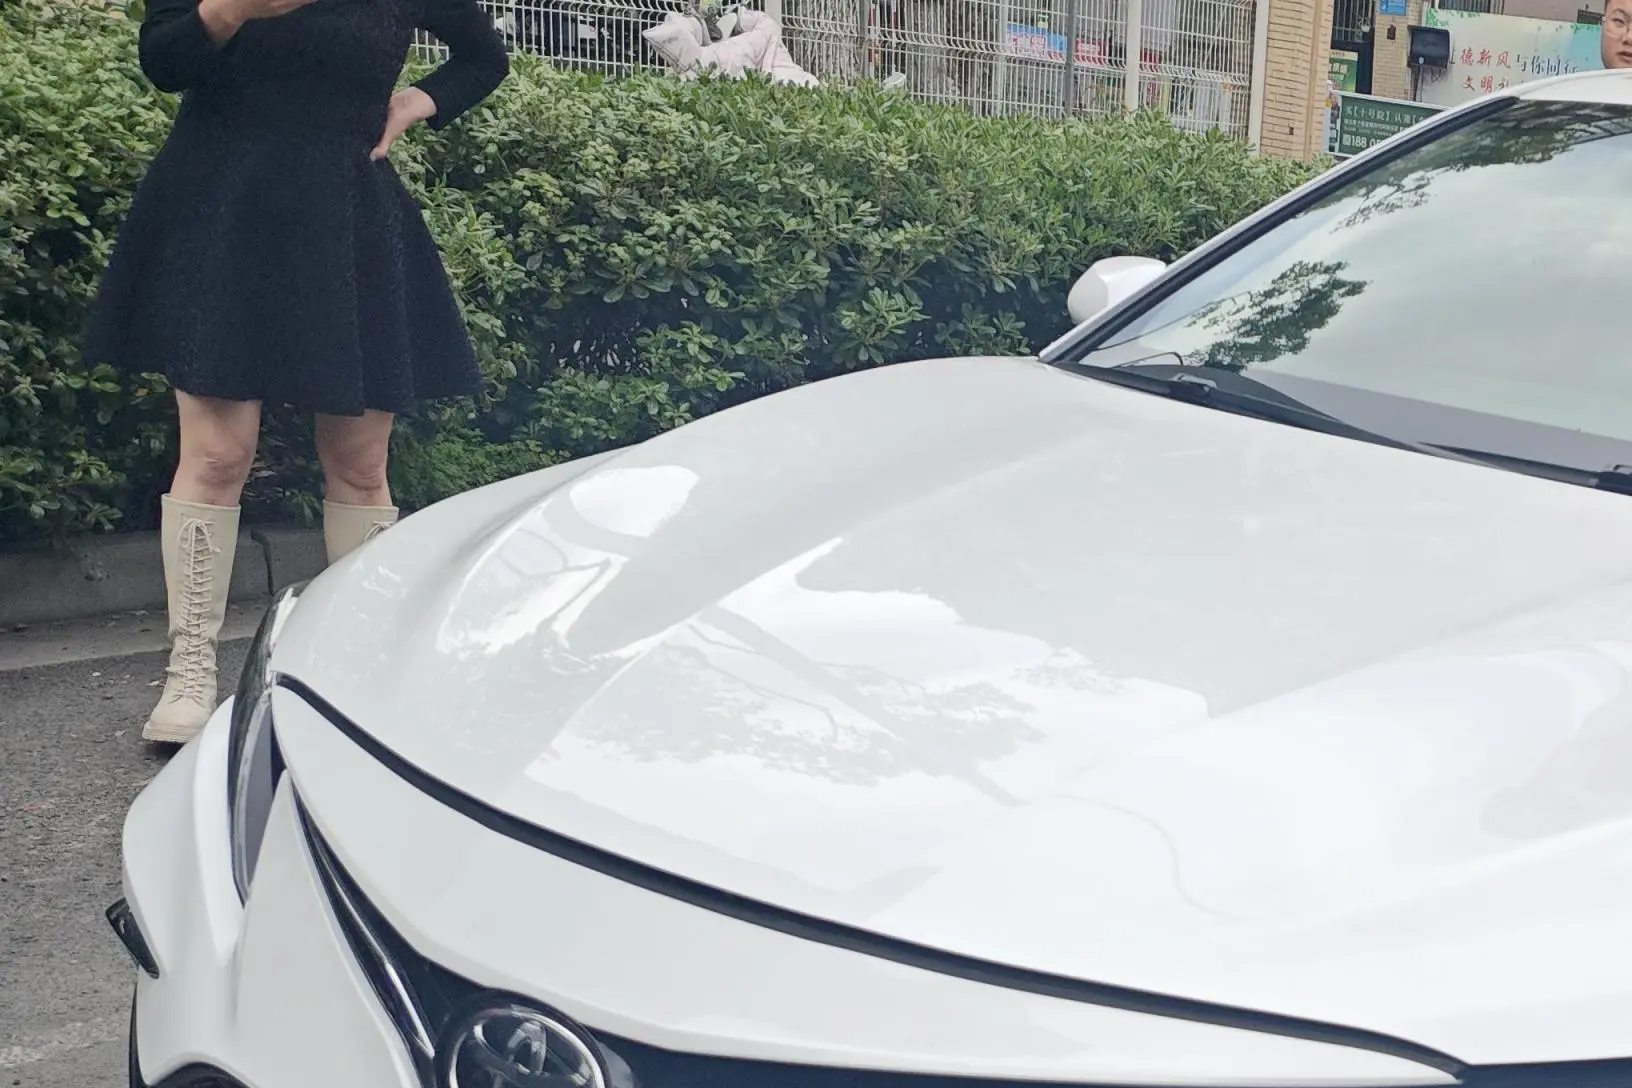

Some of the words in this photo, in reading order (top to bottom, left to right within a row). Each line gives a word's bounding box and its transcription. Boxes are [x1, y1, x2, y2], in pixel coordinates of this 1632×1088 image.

[1449, 47, 1578, 76] 德新风与你同行
